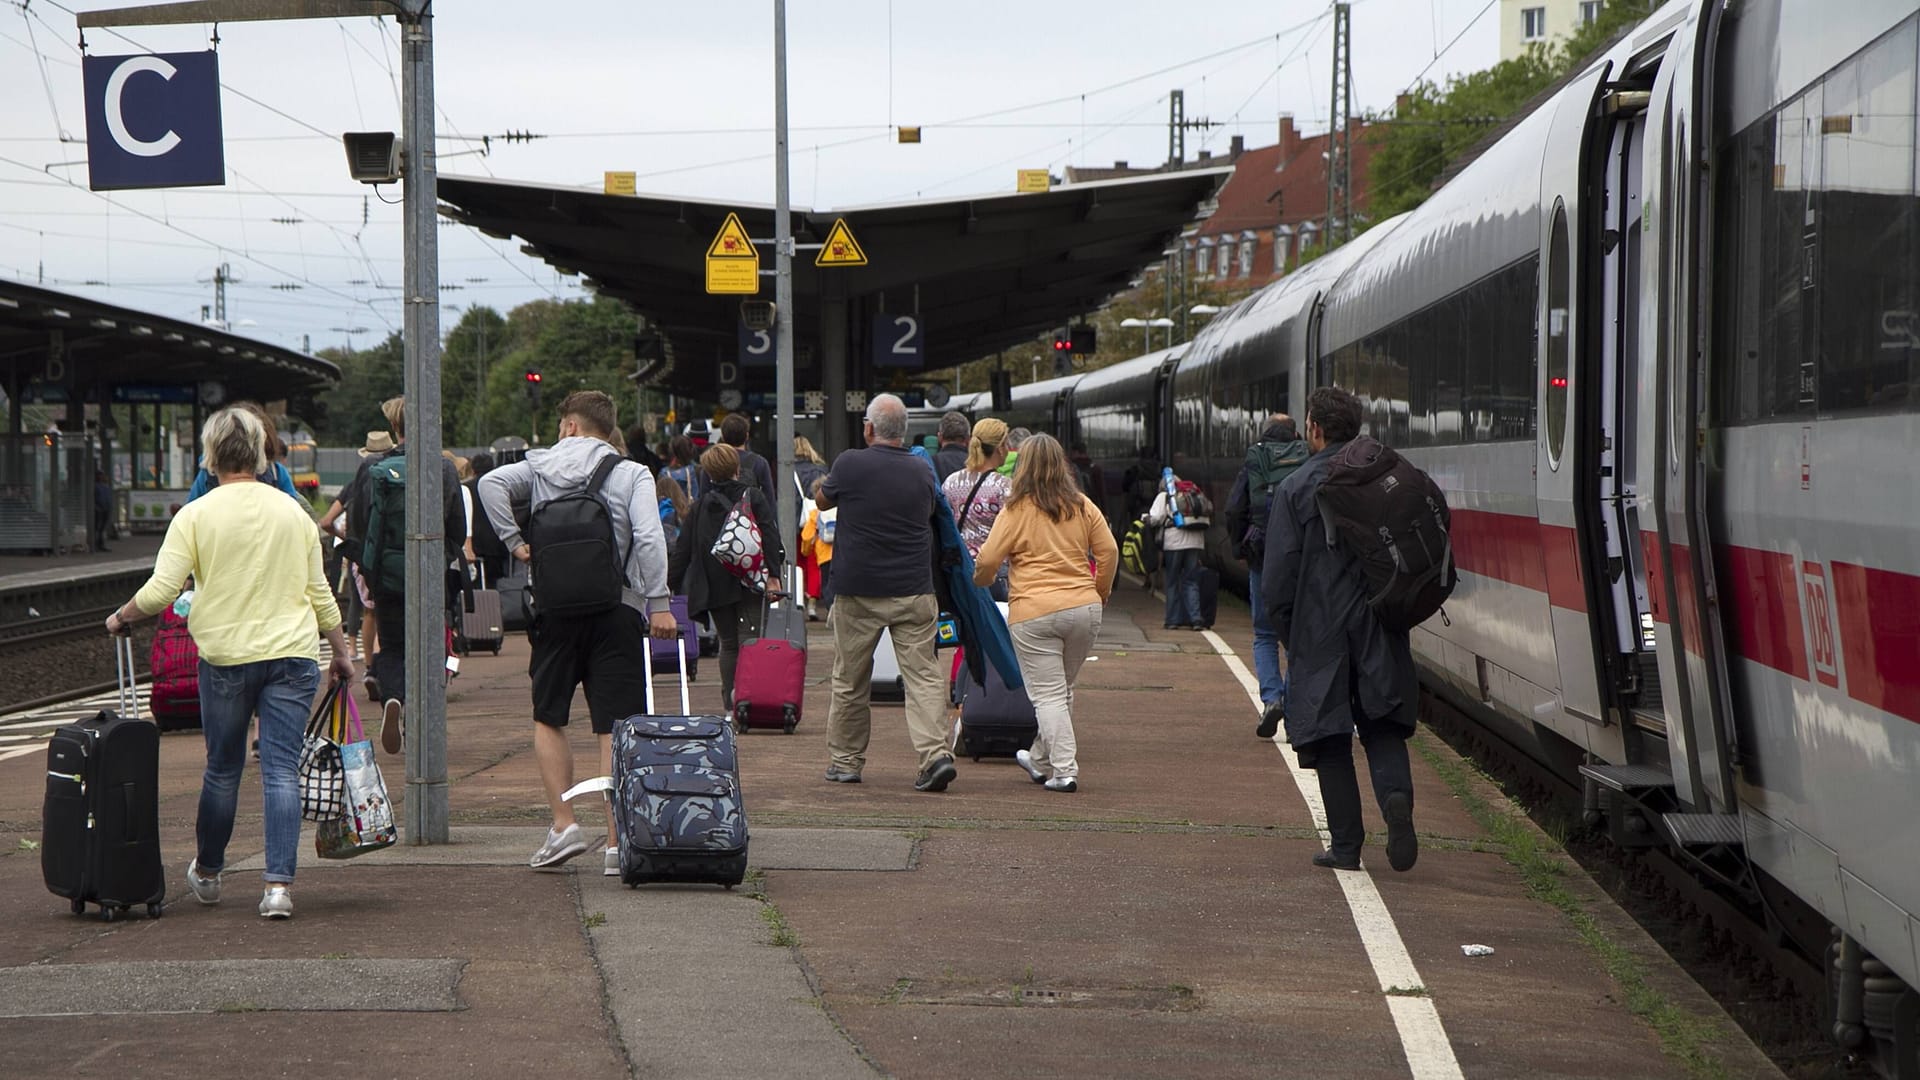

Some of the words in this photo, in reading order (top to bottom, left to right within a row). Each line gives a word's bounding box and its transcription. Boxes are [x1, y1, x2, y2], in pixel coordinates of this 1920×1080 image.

[104, 55, 182, 158] C
[745, 328, 771, 355] 3
[892, 315, 918, 355] 2
[719, 361, 737, 384] D
[1805, 579, 1833, 669] DB
